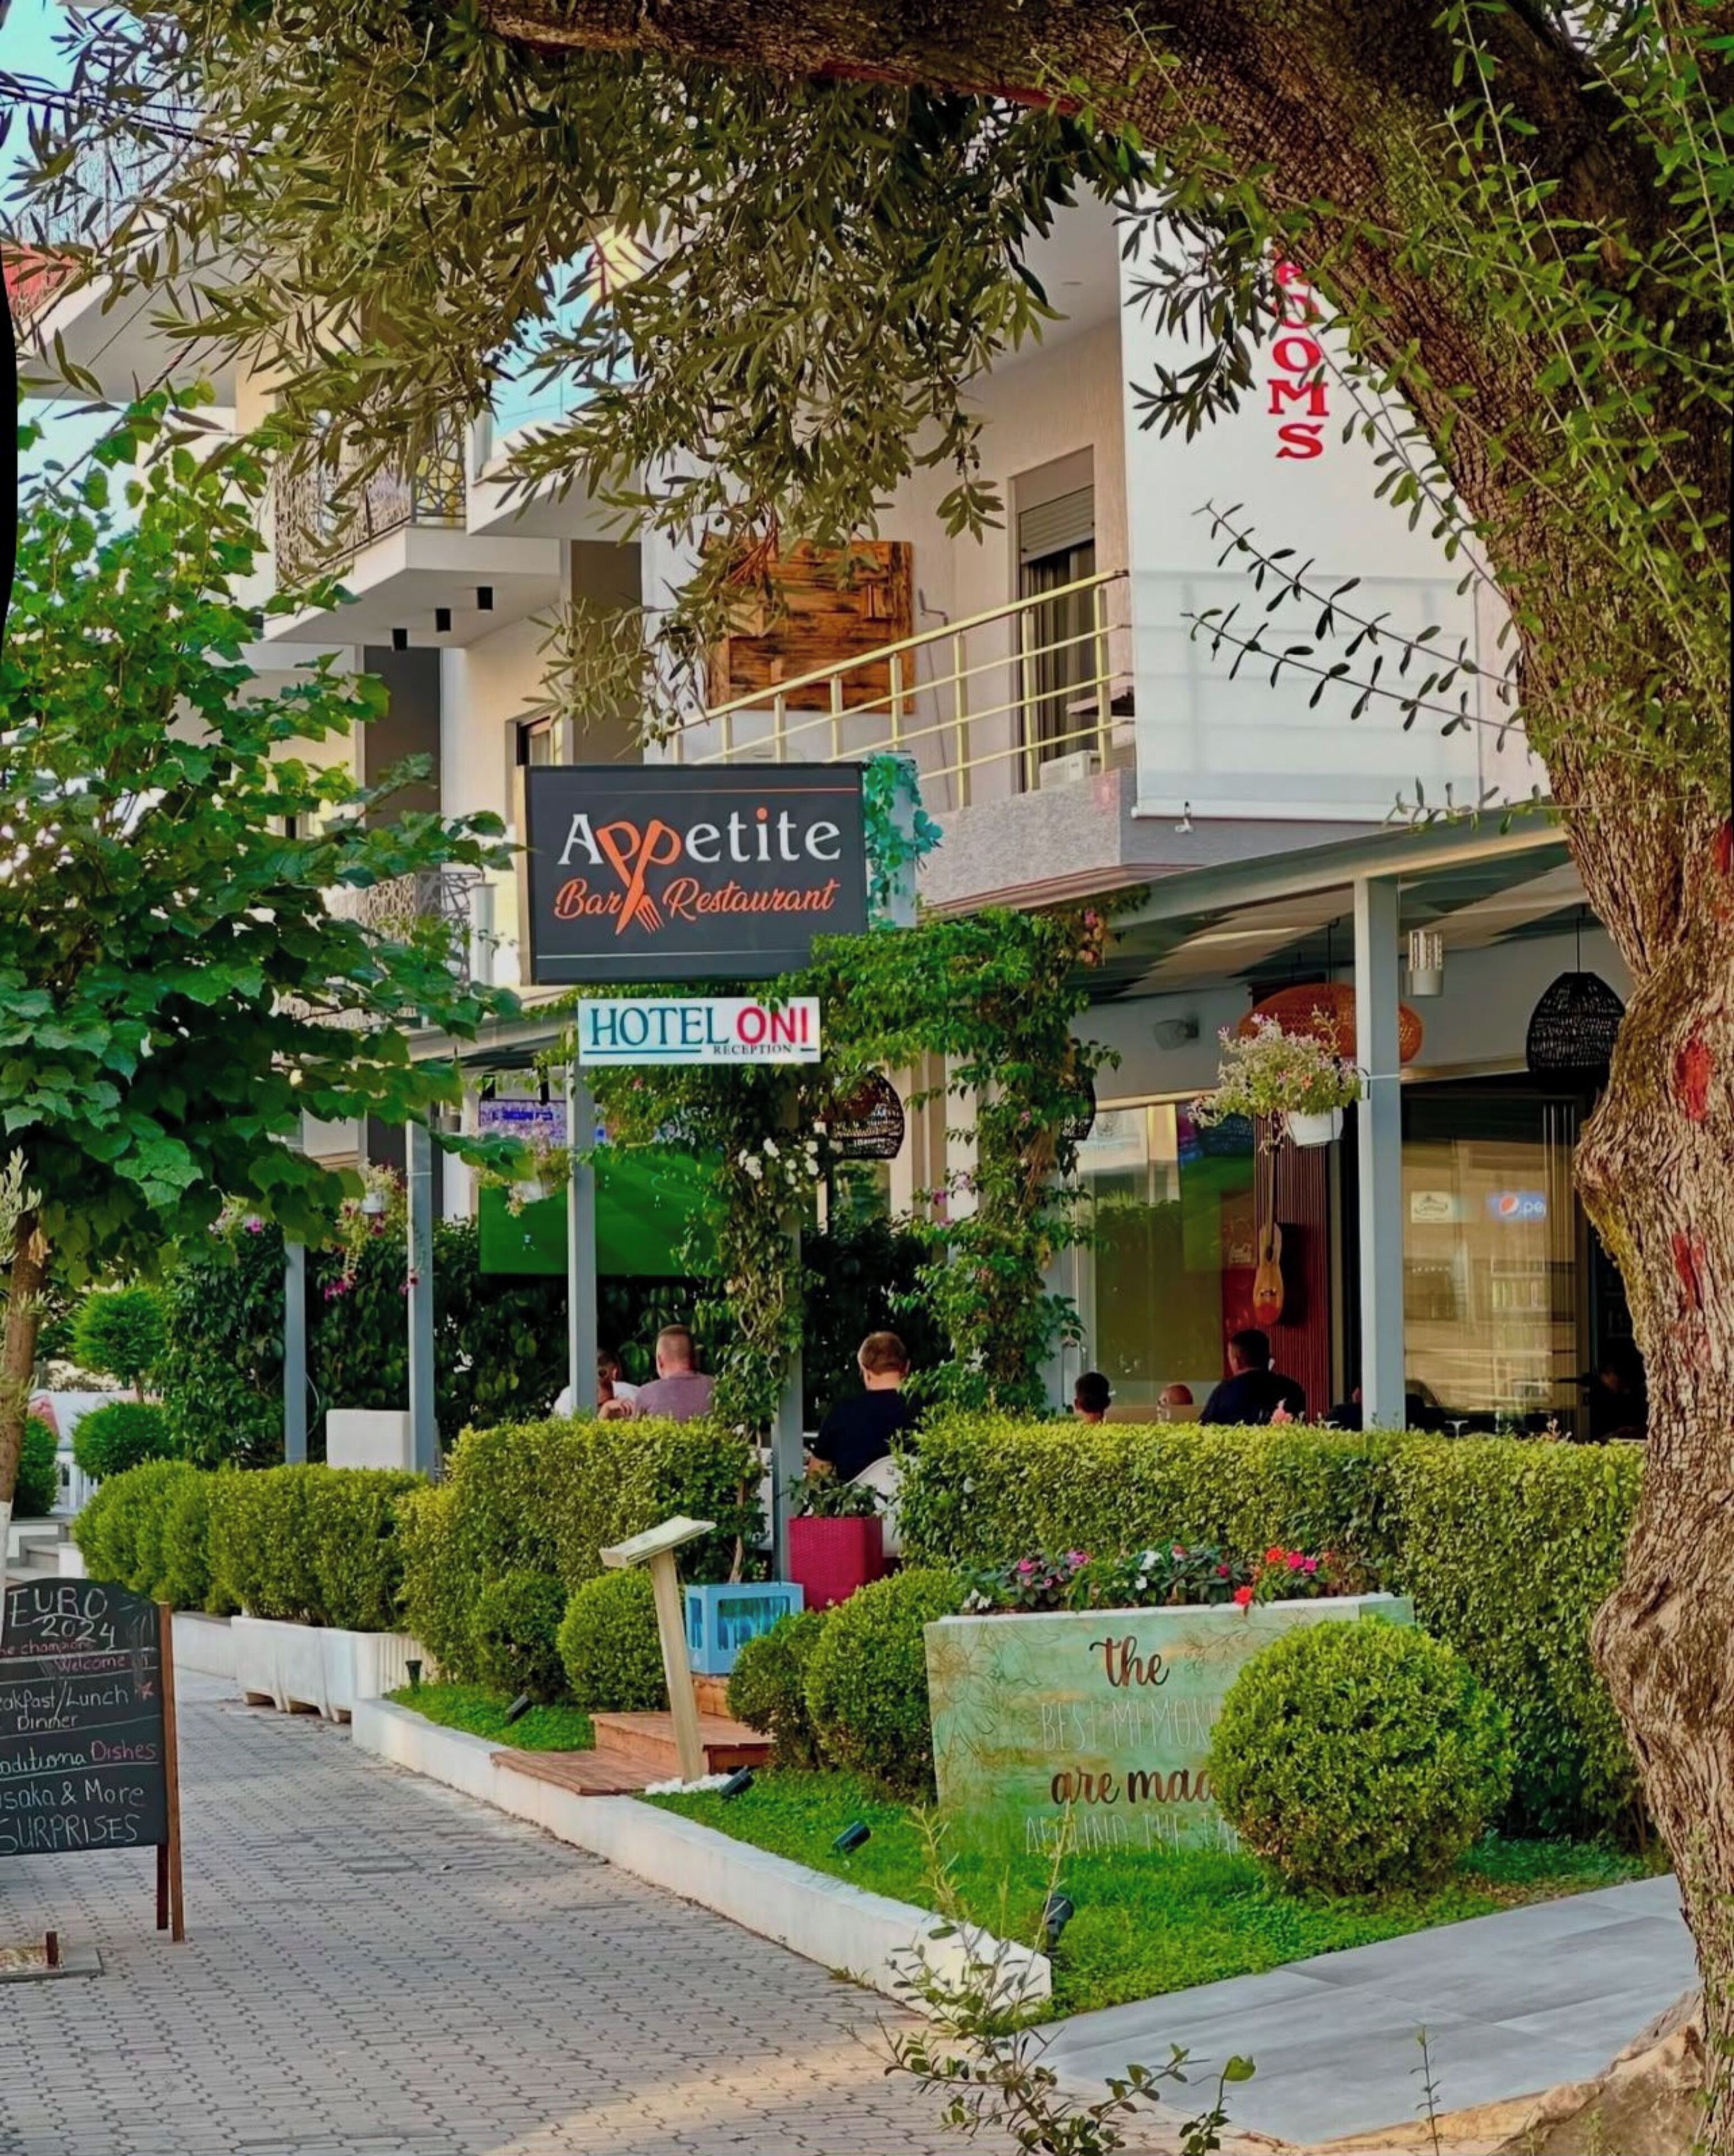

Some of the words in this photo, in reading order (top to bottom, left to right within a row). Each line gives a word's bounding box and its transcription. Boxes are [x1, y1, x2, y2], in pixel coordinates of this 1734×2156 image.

[558, 807, 841, 887] Appetite
[554, 877, 624, 919] Bar
[663, 876, 840, 922] Restaurant
[591, 1006, 729, 1044] HOTEL
[737, 1006, 808, 1045] ONI
[713, 1044, 792, 1056] RECEPTION
[8, 1586, 108, 1627] EURO
[40, 1615, 116, 1652] 2024
[54, 1655, 125, 1673] Welcome
[1089, 1636, 1170, 1687] the
[17, 1714, 79, 1730] Dinner
[90, 1739, 158, 1762] Dishes
[61, 1780, 77, 1806] &
[84, 1778, 145, 1807] More
[1051, 1766, 1120, 1805] are
[0, 1813, 140, 1853] SURPRISES
